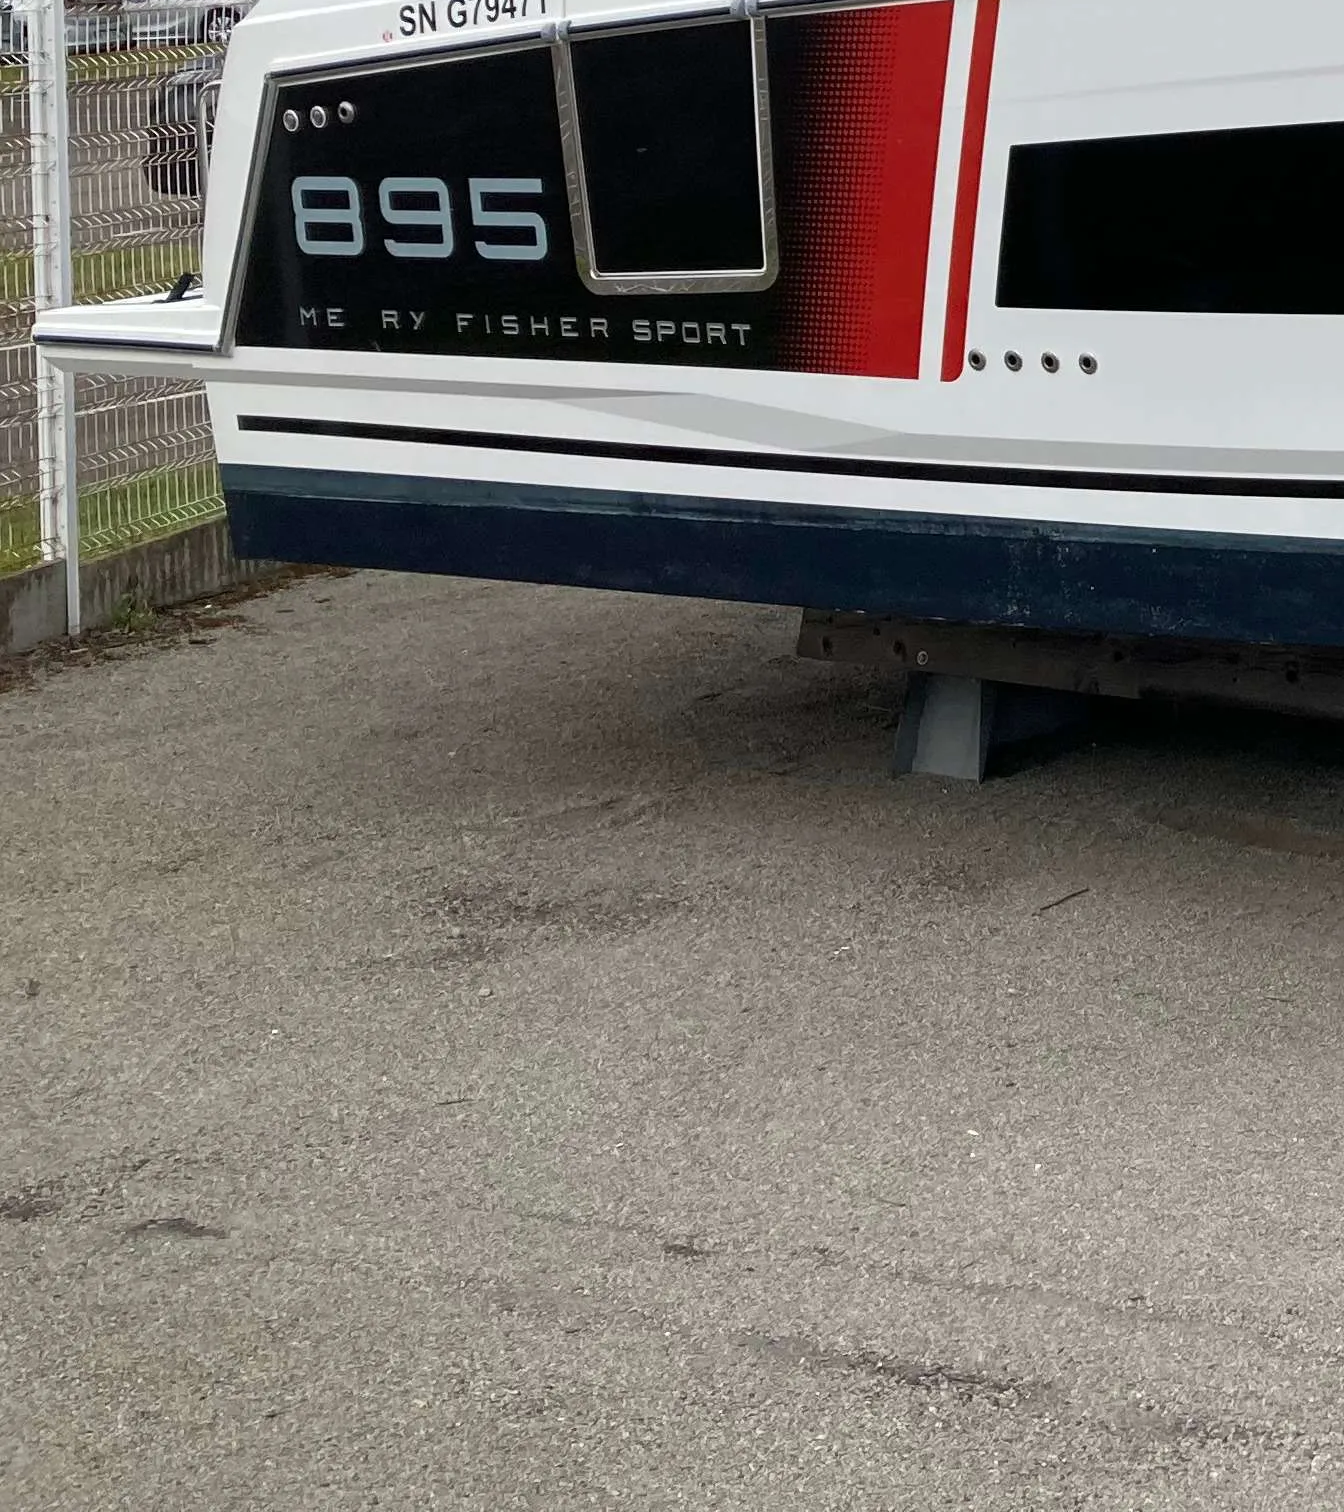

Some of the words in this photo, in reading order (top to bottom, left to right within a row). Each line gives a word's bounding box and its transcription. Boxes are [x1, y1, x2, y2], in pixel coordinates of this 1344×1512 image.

[399, 0, 437, 37] SN
[291, 175, 549, 261] 895
[456, 313, 609, 338] FISHER
[631, 318, 753, 347] SPORT
